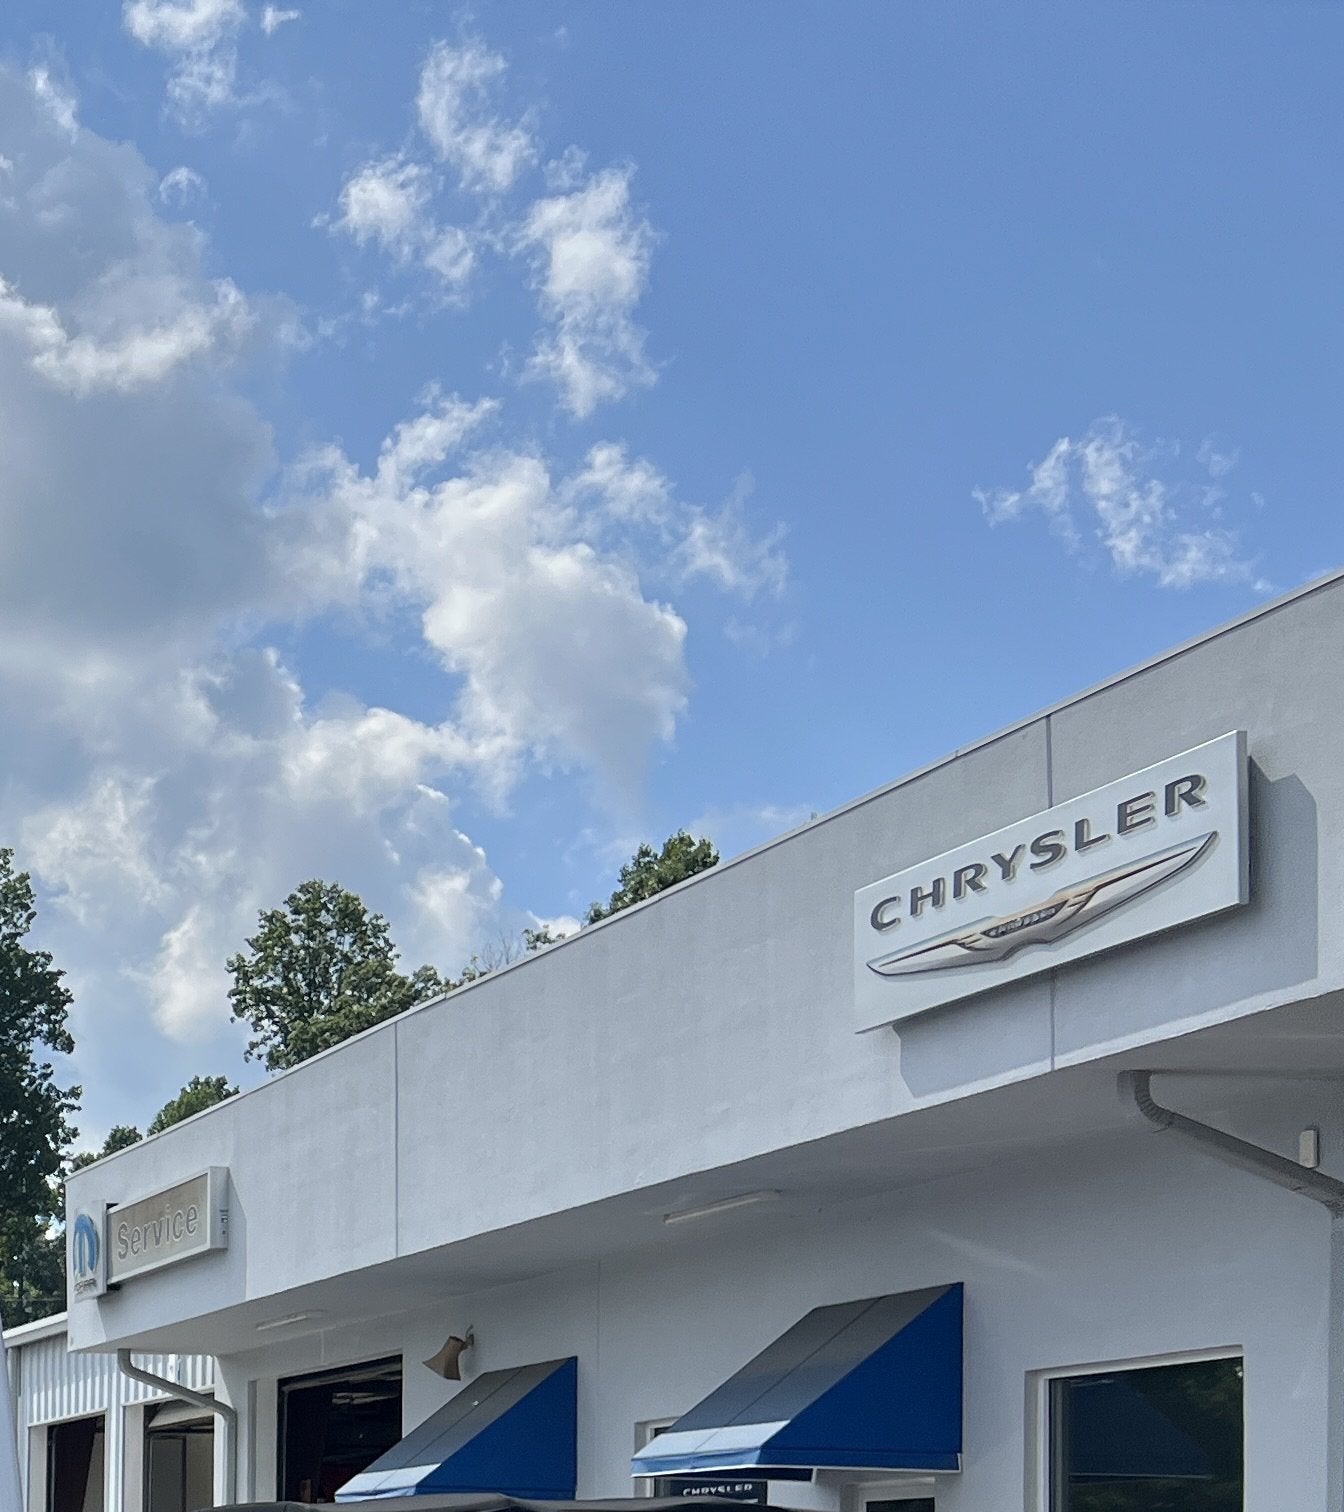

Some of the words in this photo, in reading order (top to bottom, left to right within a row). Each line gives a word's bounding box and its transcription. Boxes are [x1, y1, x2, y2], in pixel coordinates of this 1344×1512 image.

[870, 774, 1207, 932] CHRYSLER
[117, 1203, 198, 1260] Service
[682, 1483, 753, 1497] CHRYSLER
